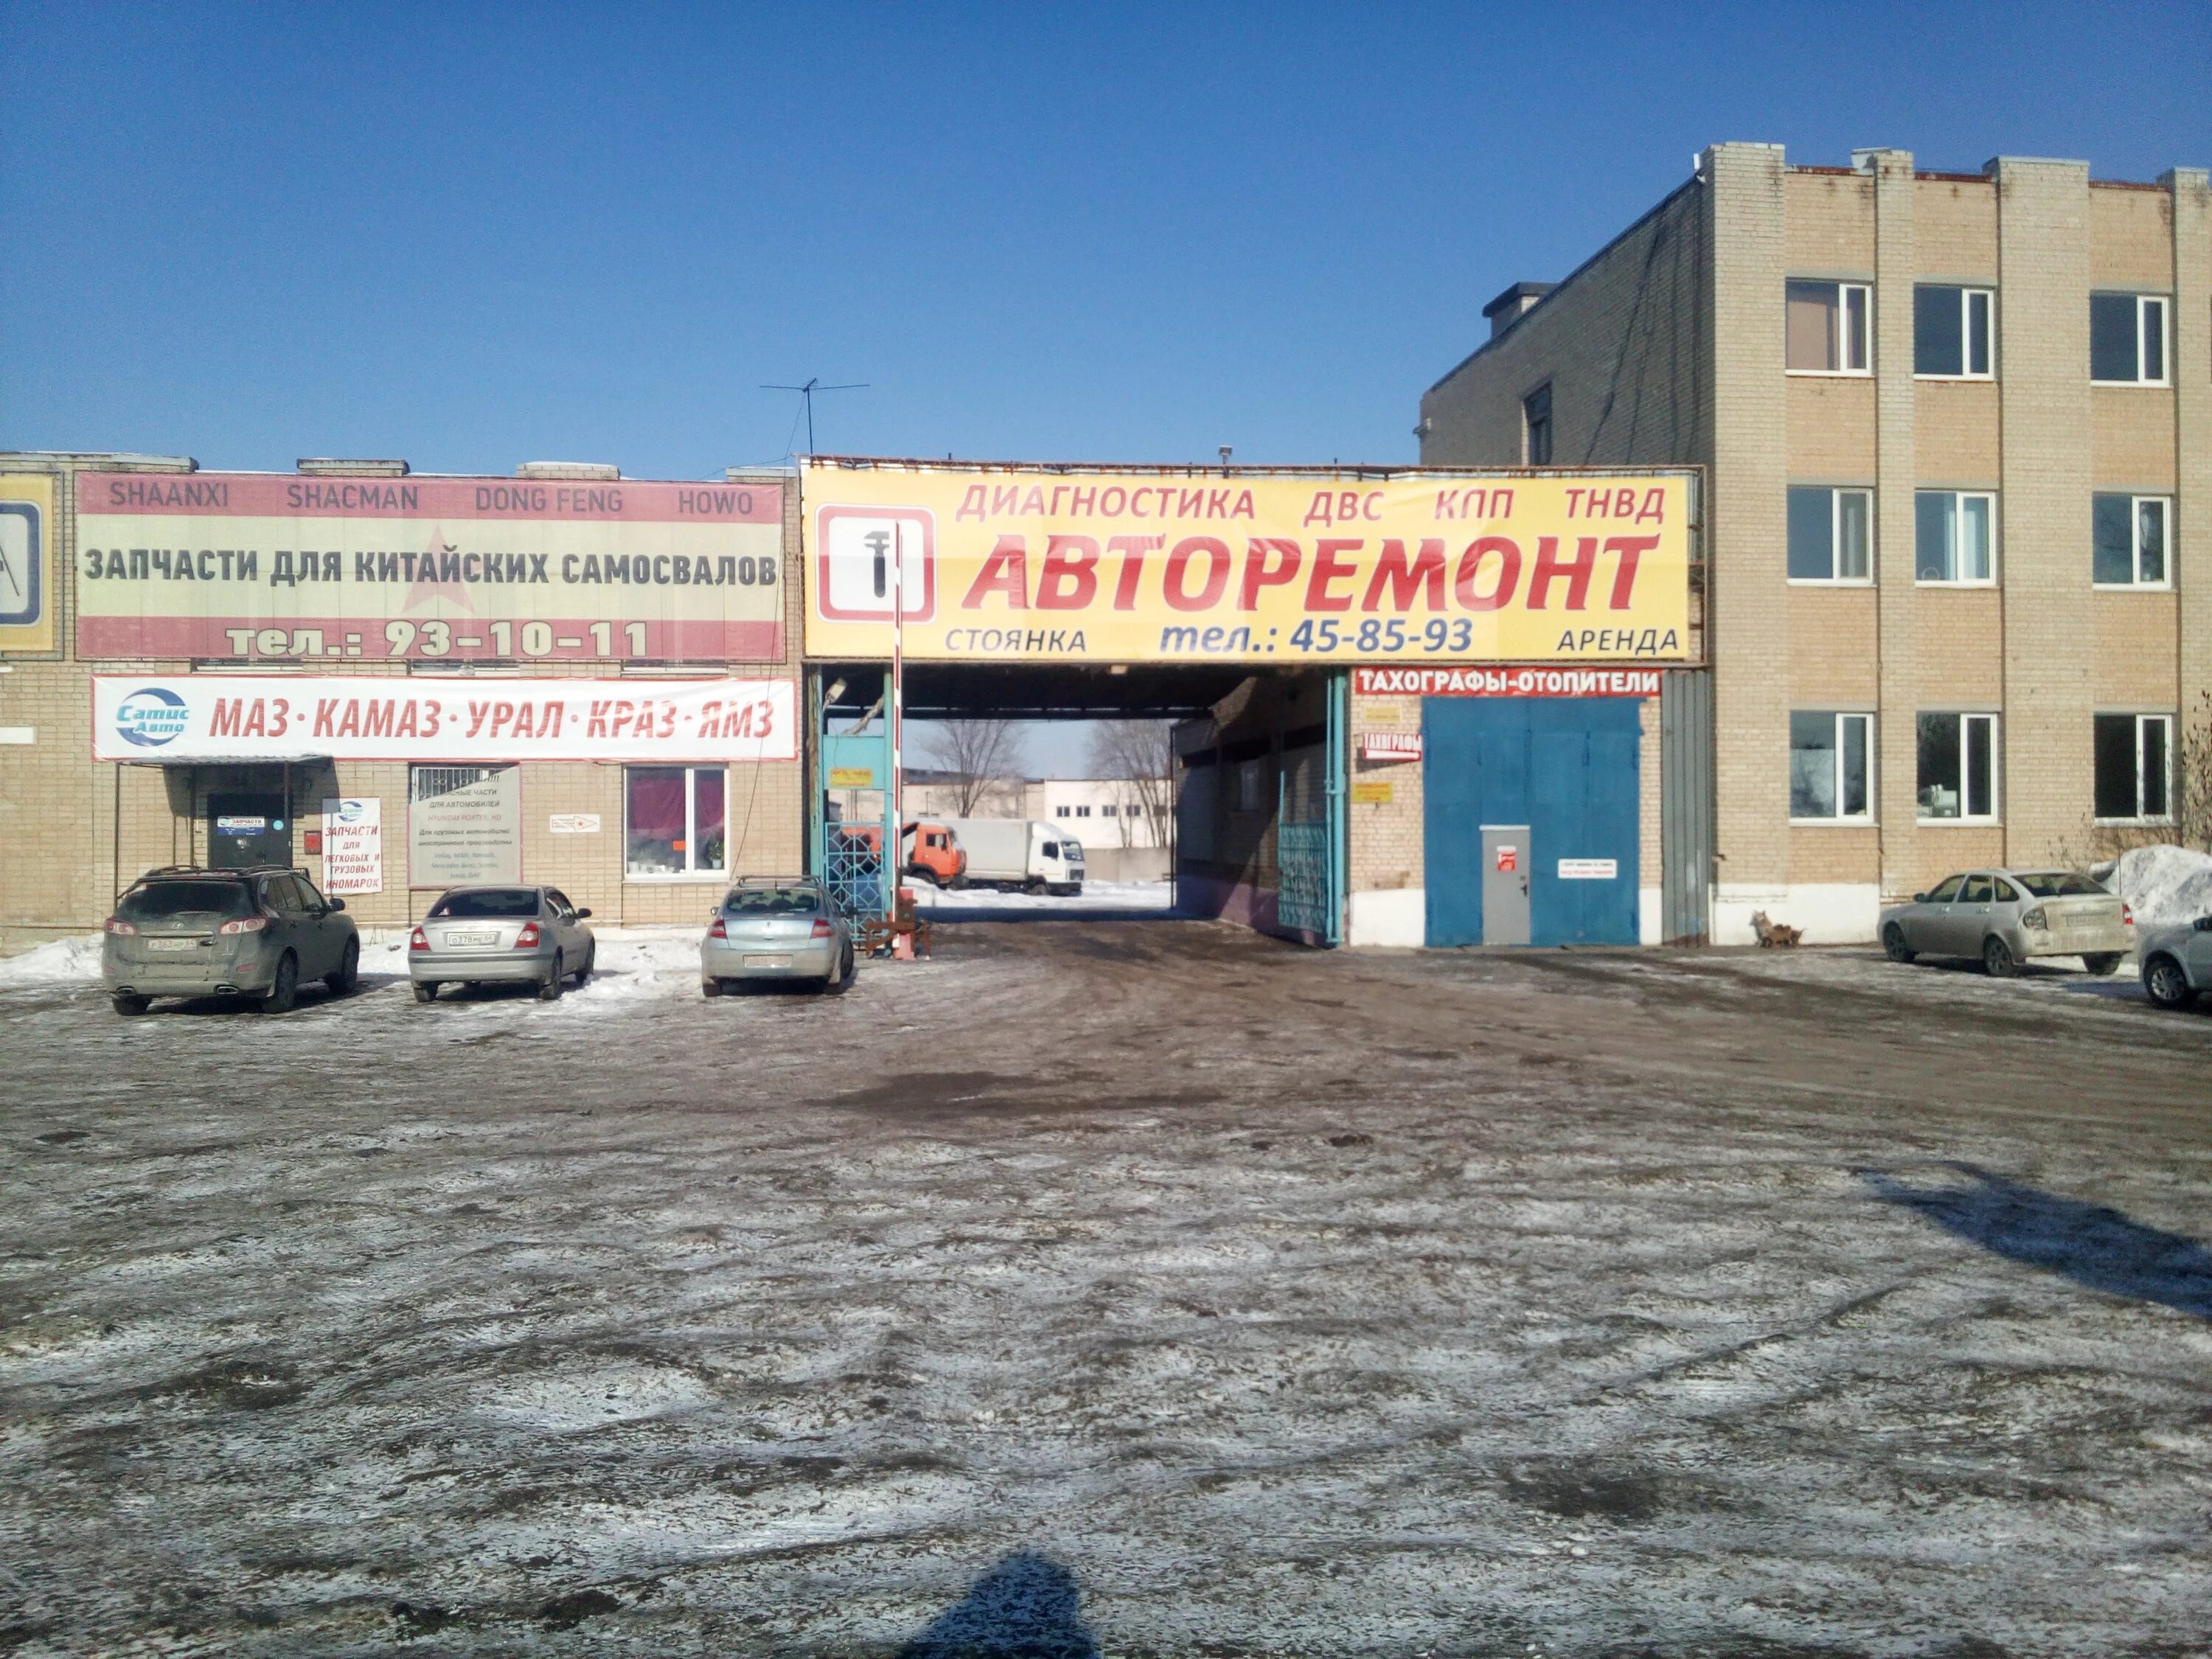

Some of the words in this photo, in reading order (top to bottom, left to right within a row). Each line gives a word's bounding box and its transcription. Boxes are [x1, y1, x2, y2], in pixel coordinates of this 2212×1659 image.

[110, 481, 229, 507] SHAANXI
[287, 484, 419, 509] SHACMAN
[476, 487, 546, 512] DONG
[557, 488, 623, 512] FENG
[678, 490, 752, 515] HOWO
[956, 484, 1255, 522] ДИАГНОСТИКА
[1434, 490, 1514, 519] КПП
[1565, 487, 1665, 524] ТНВД
[1303, 490, 1385, 527] ДВС
[84, 548, 258, 581] ЗАПЧАСТИ
[270, 551, 341, 587] ДЛЯ
[355, 544, 549, 583] КИТАЙСКИХ
[562, 554, 776, 585] САМОСВАЛОВ
[960, 532, 1660, 612] АВТОРЕМОНТ
[226, 627, 362, 655] тел.:
[385, 619, 647, 657] 93-10-11
[945, 628, 1087, 653] СТОЯНКА
[1160, 625, 1277, 653] тел.:
[1290, 618, 1473, 653] 45-85-93
[1557, 629, 1678, 655] АРЕНДА
[1359, 669, 1659, 693] ТАХОГРАФЫ-ОТОПИТЕЛИ
[116, 705, 189, 722] Сатис
[209, 698, 289, 737] МАЗ
[313, 698, 441, 737] КАМАЗ
[465, 699, 564, 737] УРАЛ
[586, 700, 677, 738] КРАЗ
[698, 700, 773, 738] ЯМЗ
[134, 722, 184, 732] Авто
[325, 825, 378, 836] ЗАПЧАСТИ
[342, 841, 361, 849] ДЛЯ
[324, 854, 369, 863] ЛЕГКОВЫХ
[331, 865, 375, 874] ГРУЗОВЫХ
[325, 878, 379, 889] ИНОМАРОК
